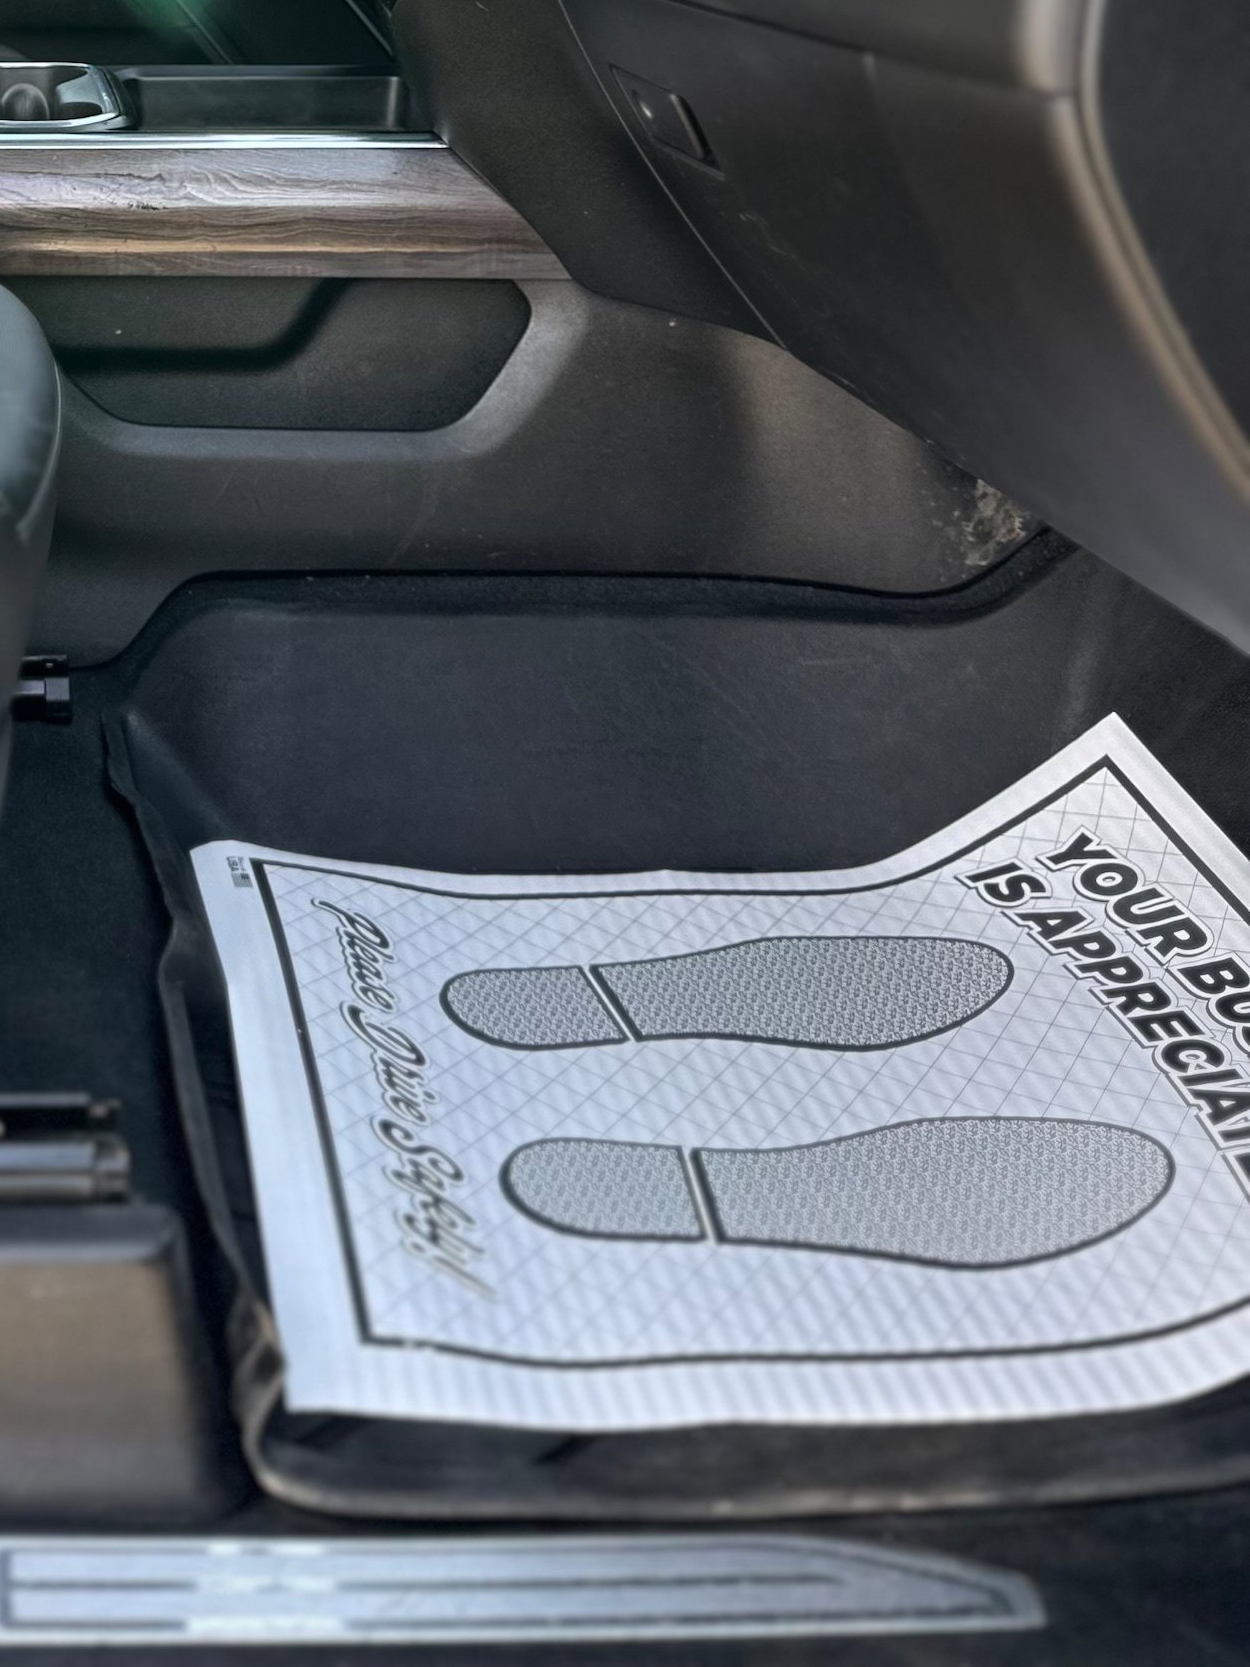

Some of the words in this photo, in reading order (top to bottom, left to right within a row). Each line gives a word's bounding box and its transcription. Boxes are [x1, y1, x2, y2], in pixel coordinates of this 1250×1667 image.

[311, 896, 395, 1014] Please
[959, 859, 1050, 905] IS
[1006, 907, 1250, 1190] APPRECIA
[1041, 828, 1211, 961] YOUR
[1170, 954, 1250, 1056] BU
[342, 1001, 441, 1125] Drive
